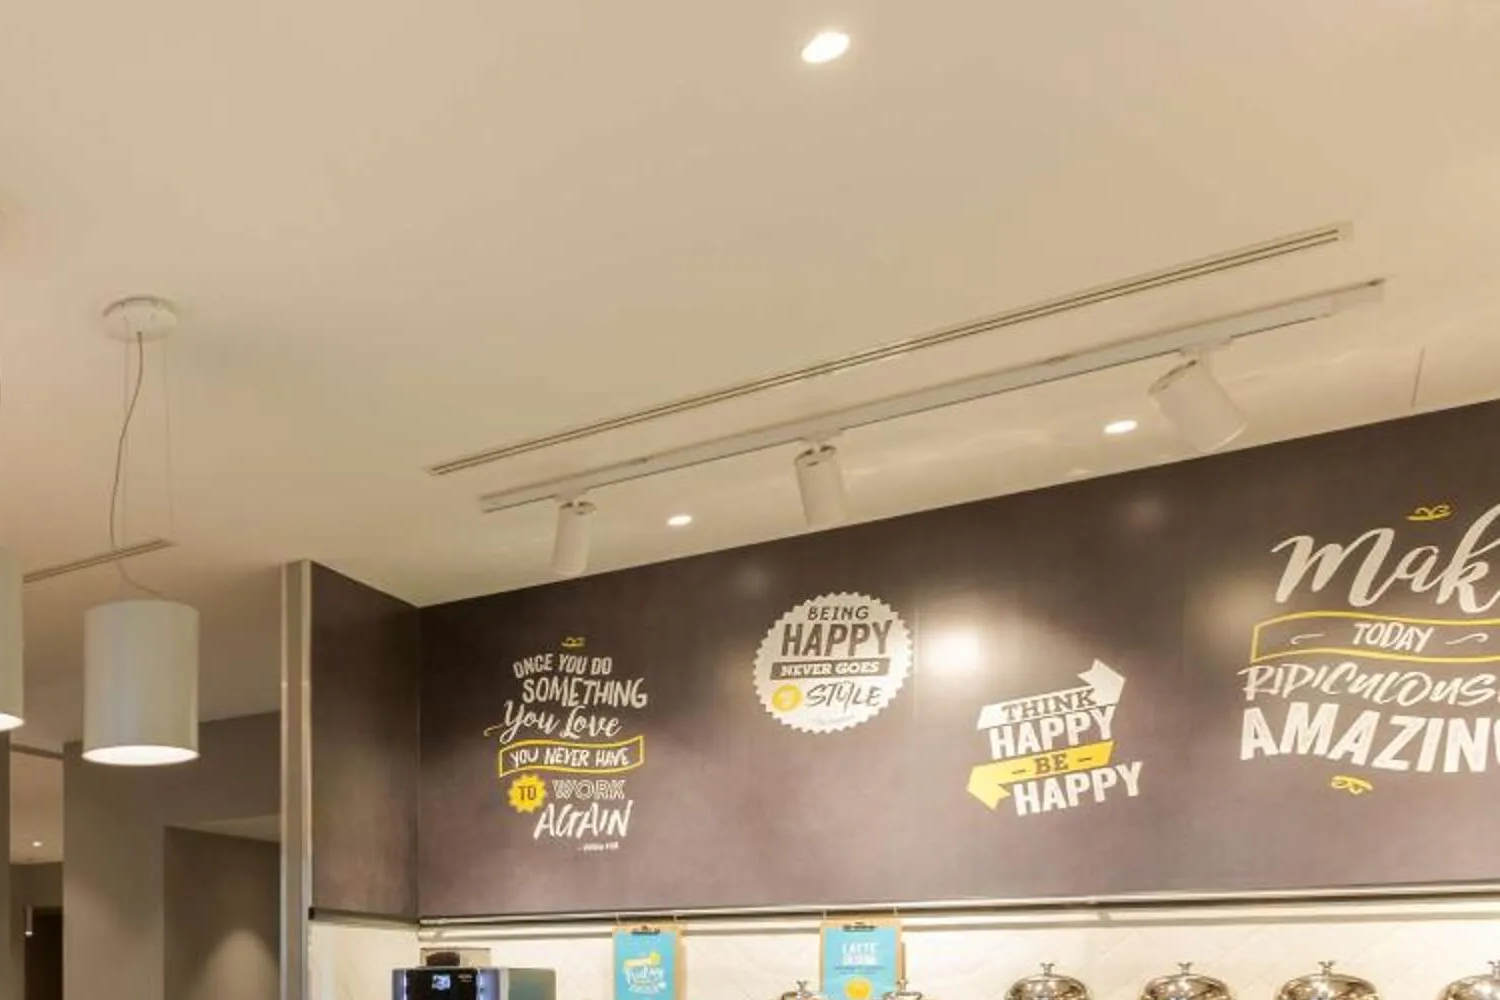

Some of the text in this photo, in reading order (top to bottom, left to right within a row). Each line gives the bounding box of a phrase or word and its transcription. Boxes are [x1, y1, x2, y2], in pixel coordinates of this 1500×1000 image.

[1271, 504, 1500, 613] Mak
[808, 606, 869, 620] BEING
[781, 620, 892, 656] HAPPY
[1352, 622, 1434, 653] TODAY
[513, 653, 612, 678] ONCE YOU DO
[780, 661, 879, 677] NEVER GOES
[522, 676, 648, 708] SOMETHING
[805, 681, 882, 713] STYLE
[1237, 662, 1500, 707] RIDICULOUS
[1002, 688, 1096, 721] THINK
[485, 700, 621, 744] You Love
[989, 706, 1116, 760] HAPPY
[1239, 701, 1500, 773] AMAZIN
[510, 747, 630, 768] YOU NEVER HAVE
[1033, 754, 1069, 775] BE
[518, 779, 626, 800] TO WORK
[1013, 761, 1143, 816] HAPPY
[533, 800, 633, 839] AGAIN
